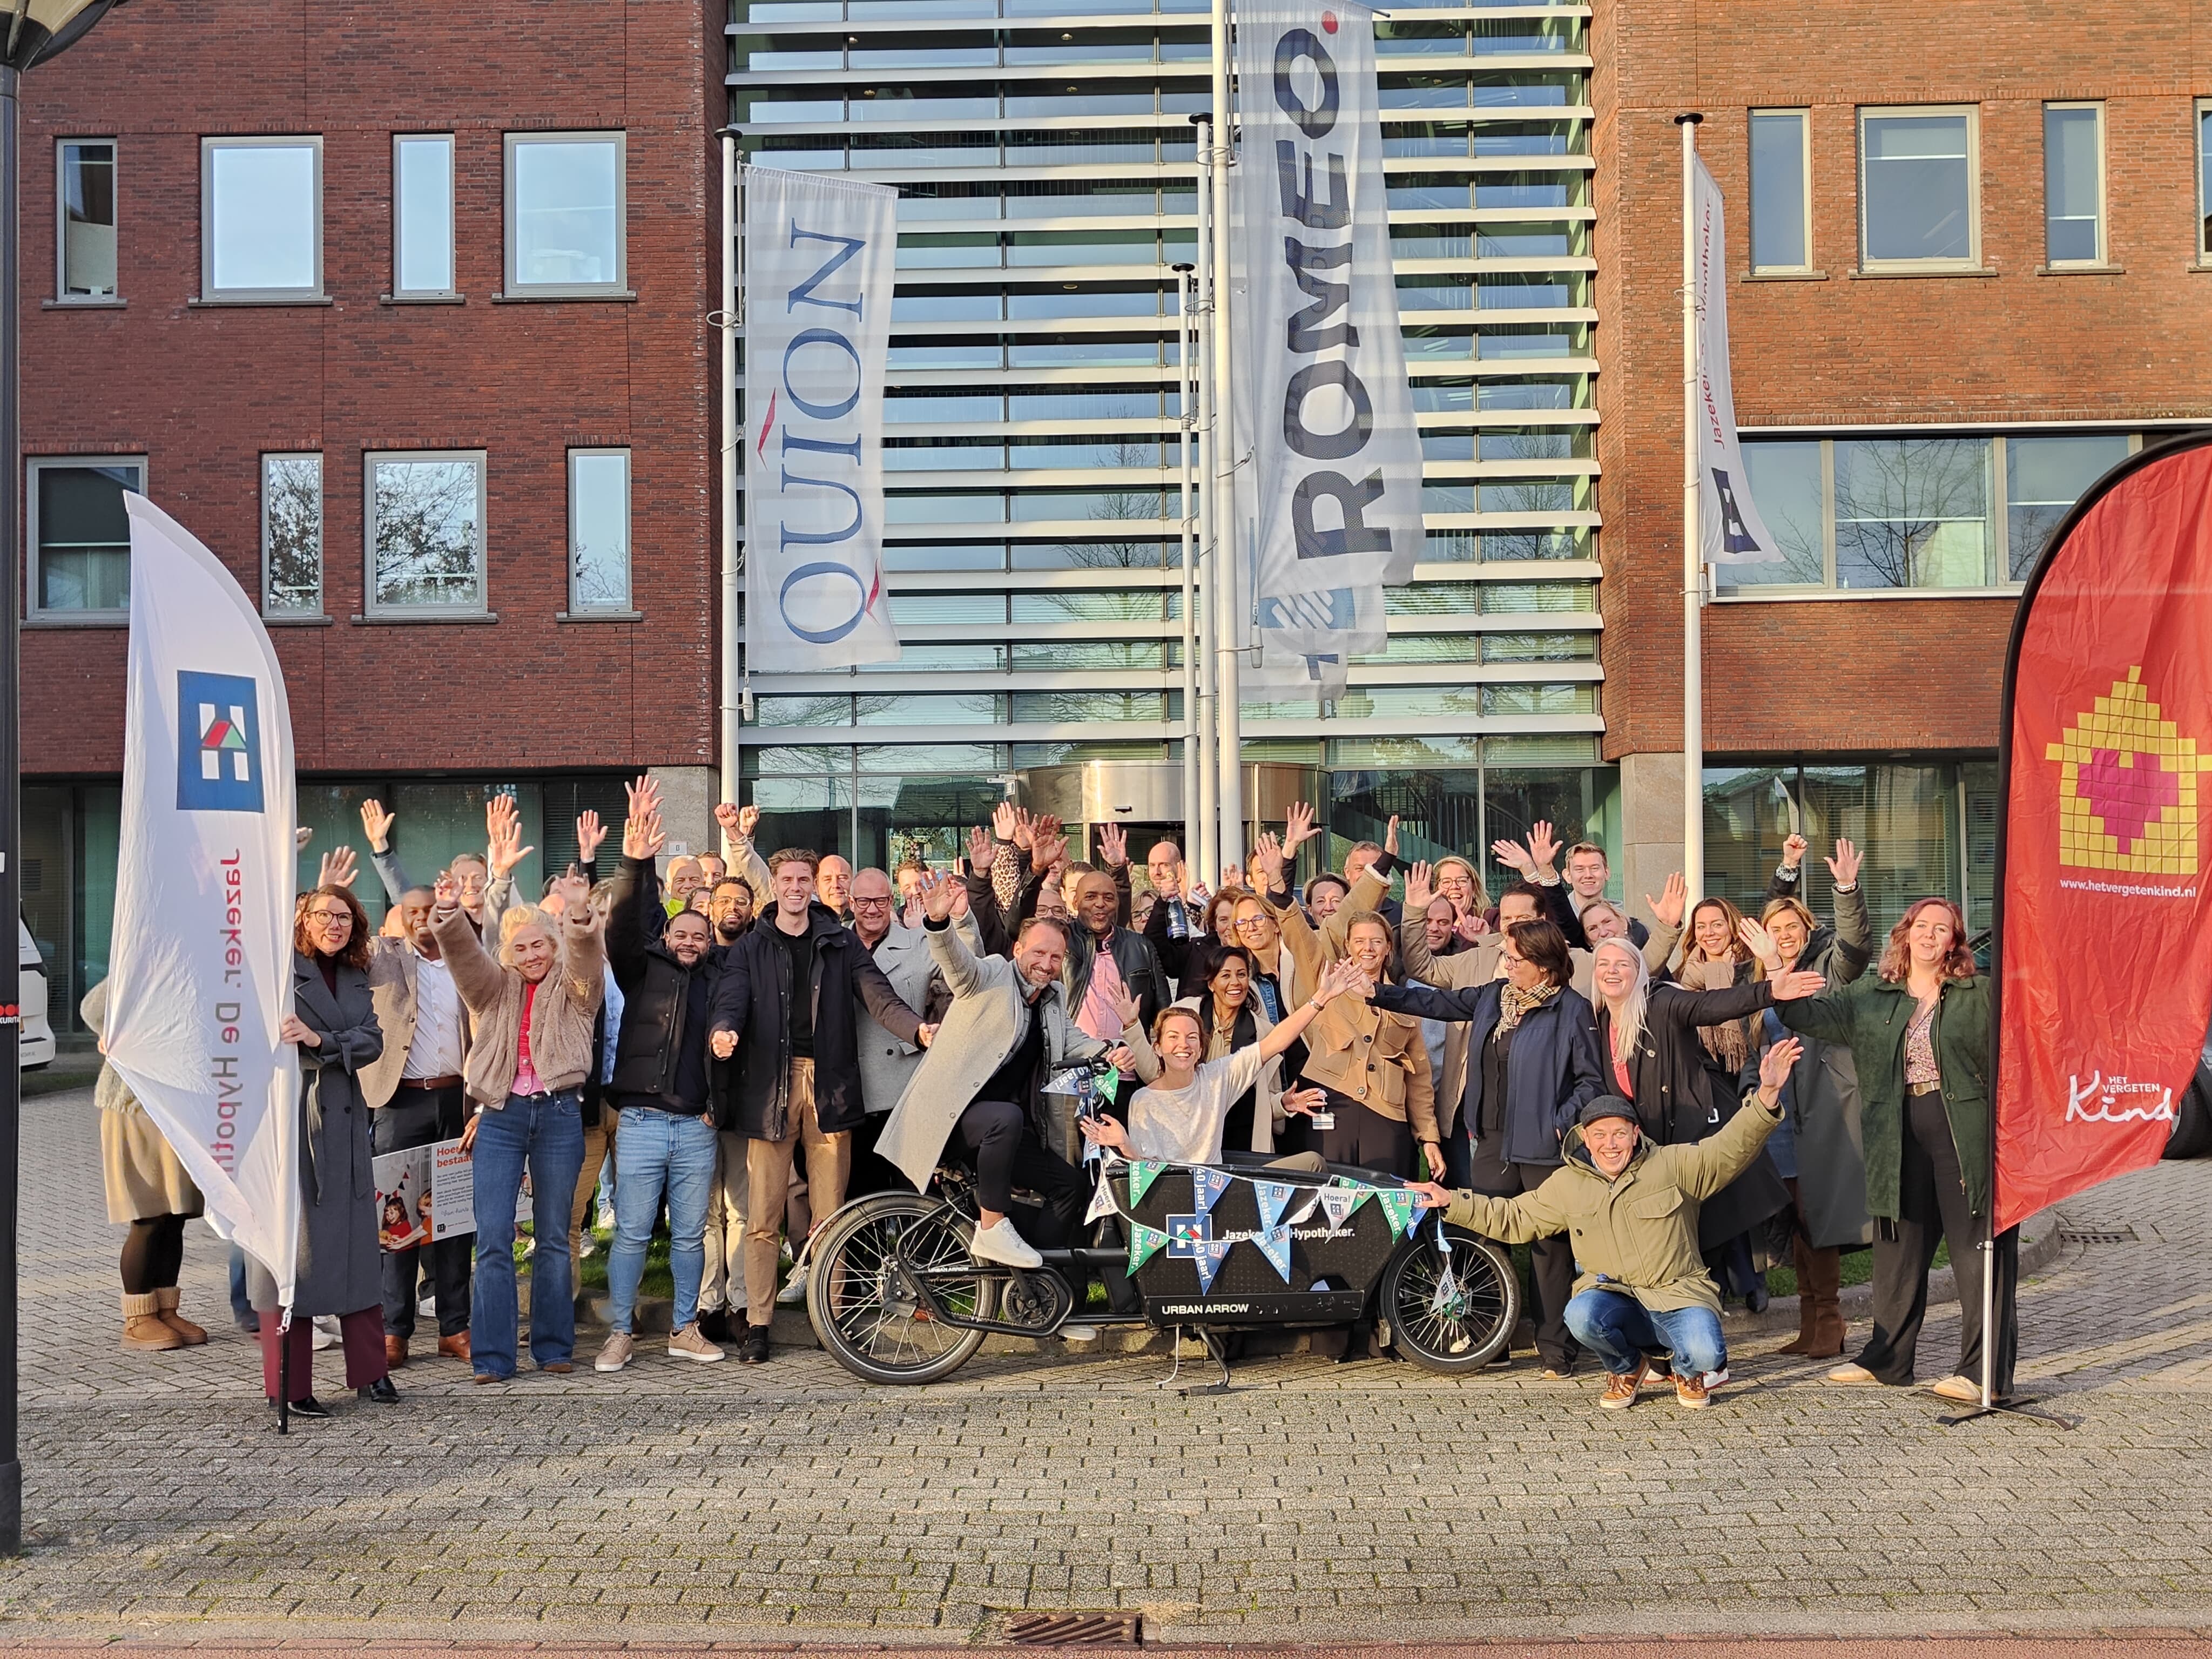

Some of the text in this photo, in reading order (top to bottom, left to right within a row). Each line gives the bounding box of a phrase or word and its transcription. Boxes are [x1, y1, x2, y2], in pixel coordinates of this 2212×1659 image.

[778, 217, 880, 644] QUION
[2060, 878, 2196, 898] www.hetvergetenkind.nl
[1055, 1070, 1078, 1090] jaar!
[2065, 1070, 2174, 1122] Kind
[2102, 1083, 2160, 1094] VERGETEN
[2108, 1076, 2128, 1084] HET
[1131, 1162, 1143, 1197] azeker.
[1195, 1168, 1208, 1211] 40 jaar!
[1257, 1183, 1272, 1228] Jazeker.
[1324, 1193, 1351, 1203] Hoera!
[1380, 1192, 1402, 1235] Jazeker.
[1131, 1224, 1144, 1270] Jazeker.
[1256, 1235, 1287, 1273] Jazeker.
[1195, 1255, 1212, 1280] jaar!
[1162, 1303, 1249, 1315] URBAN ARROW
